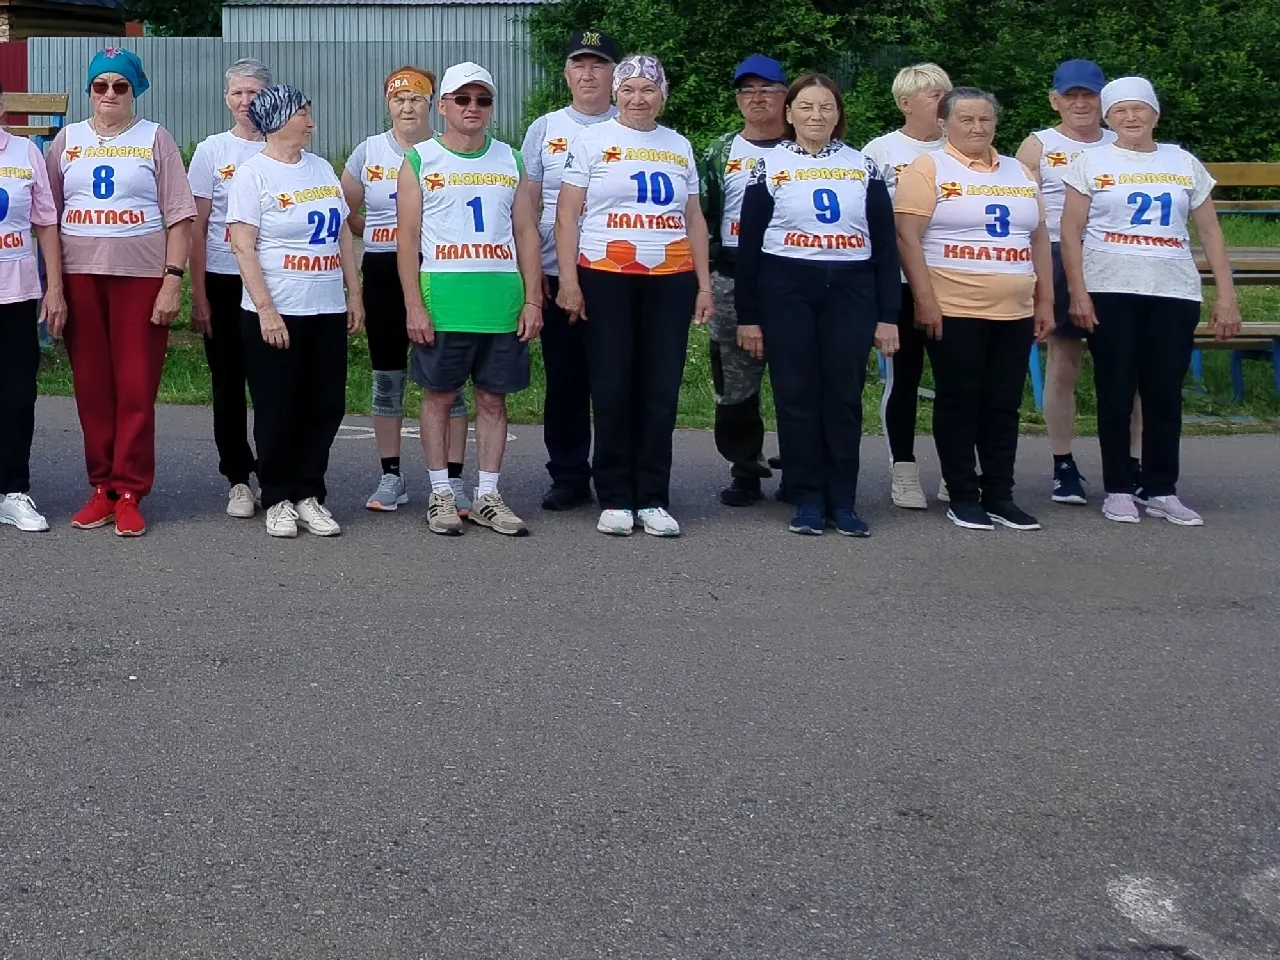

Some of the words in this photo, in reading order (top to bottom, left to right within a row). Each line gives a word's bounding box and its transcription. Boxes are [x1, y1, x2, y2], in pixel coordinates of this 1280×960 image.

[84, 146, 152, 159] ДОВЕРИЕ
[624, 147, 689, 167] ДОВЕРИЕ
[93, 166, 115, 200] 8
[448, 173, 516, 188] ДОВЕРИЕ
[630, 171, 674, 206] 10
[1118, 173, 1192, 187] ДОВЕРИЕ
[966, 184, 1036, 198] ДОВЕРИЕ
[466, 197, 485, 232] 1
[813, 188, 841, 224] 9
[1127, 192, 1172, 227] 21
[66, 210, 146, 224] КАЛТАСЫ
[308, 208, 340, 244] 24
[607, 213, 684, 229] КАЛТАСЫ
[985, 204, 1010, 238] 3
[784, 233, 864, 249] КАЛТАСЫ
[435, 244, 513, 261] КАЛТАСЫ
